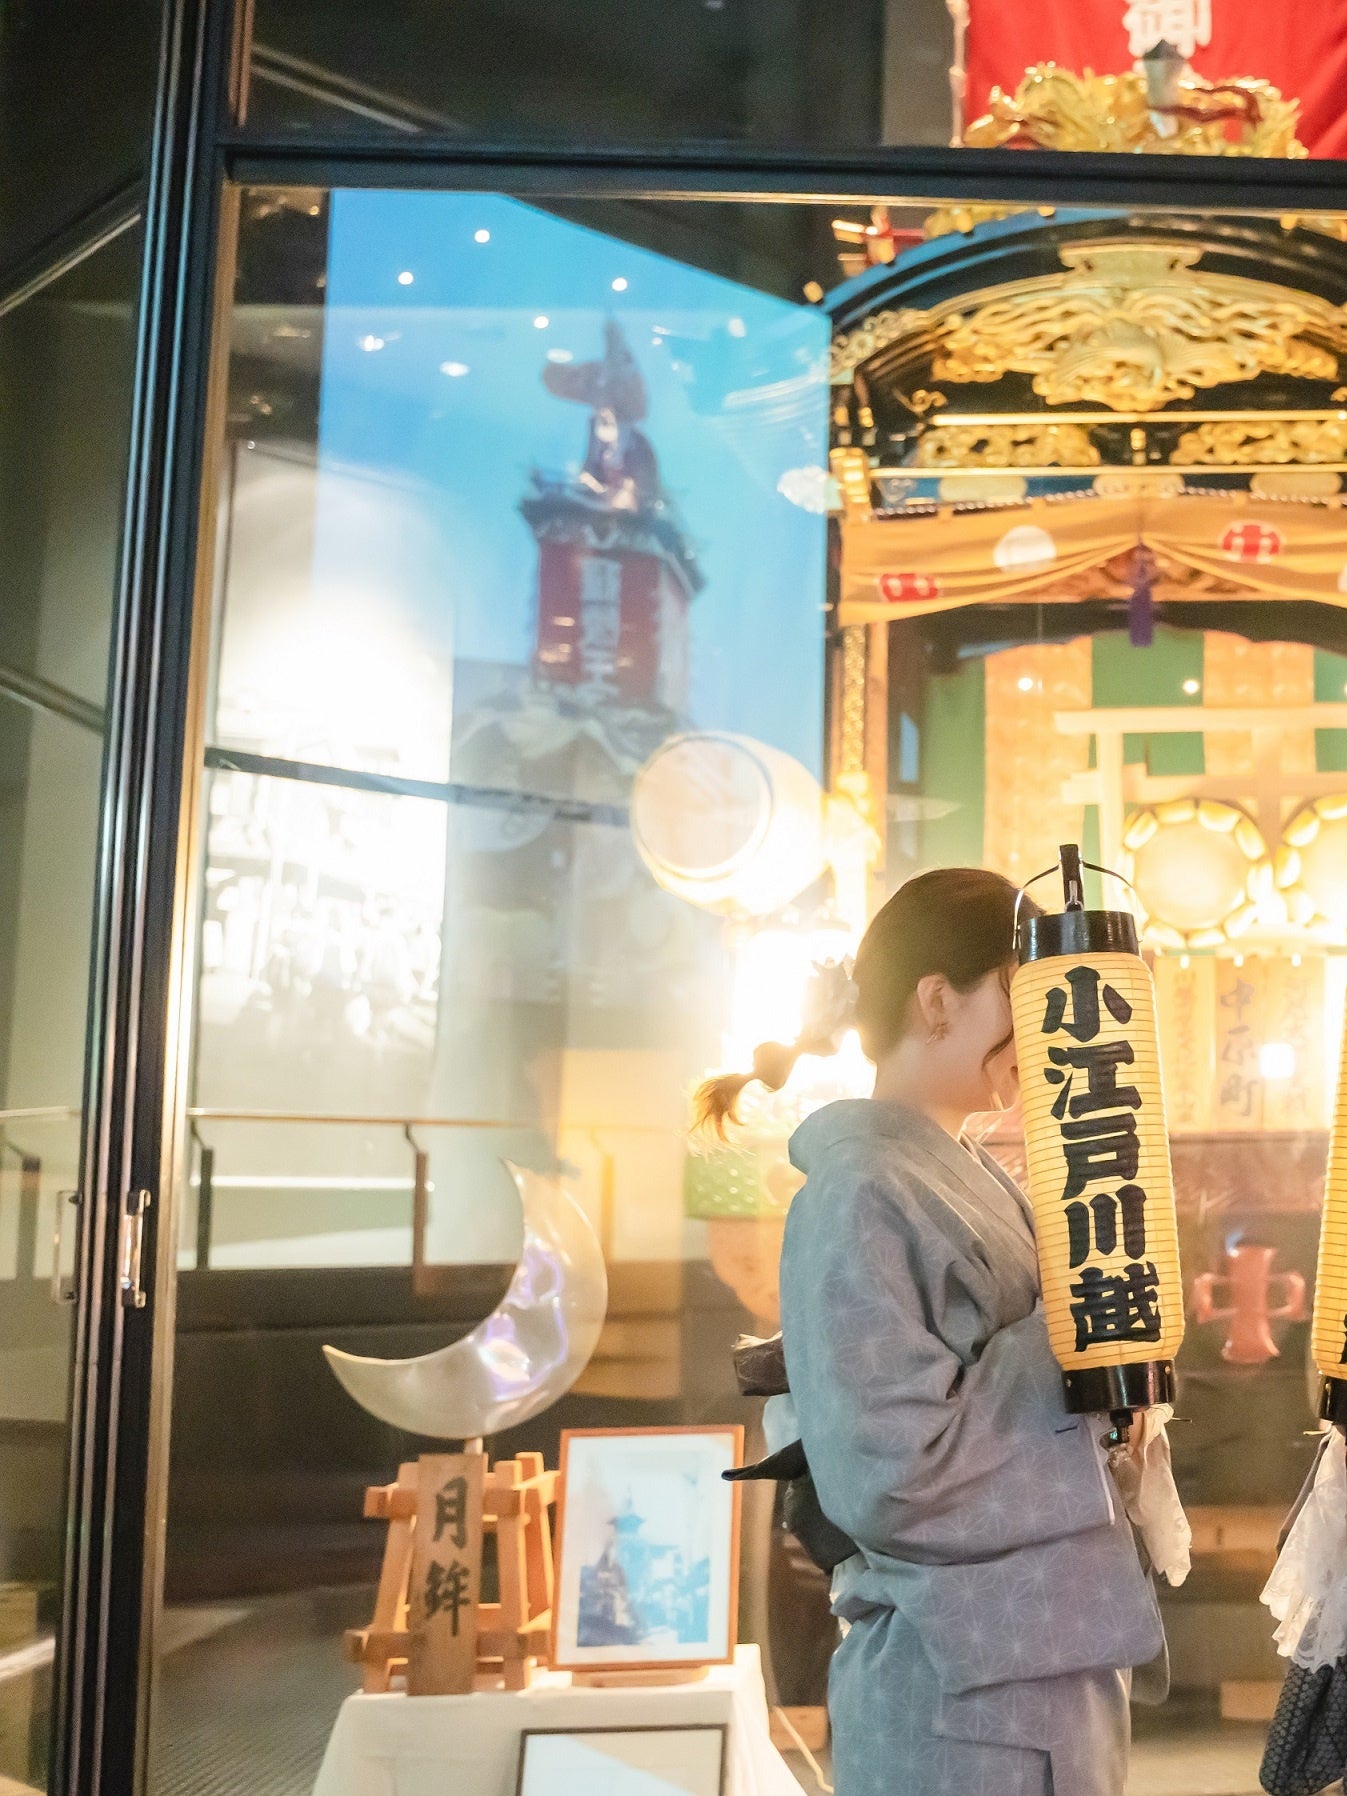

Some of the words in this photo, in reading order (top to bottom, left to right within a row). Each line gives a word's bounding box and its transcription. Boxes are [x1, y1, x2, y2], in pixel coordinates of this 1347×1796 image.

[1041, 966, 1163, 1353] 小江戸川越
[424, 1475, 471, 1638] 月鉾
